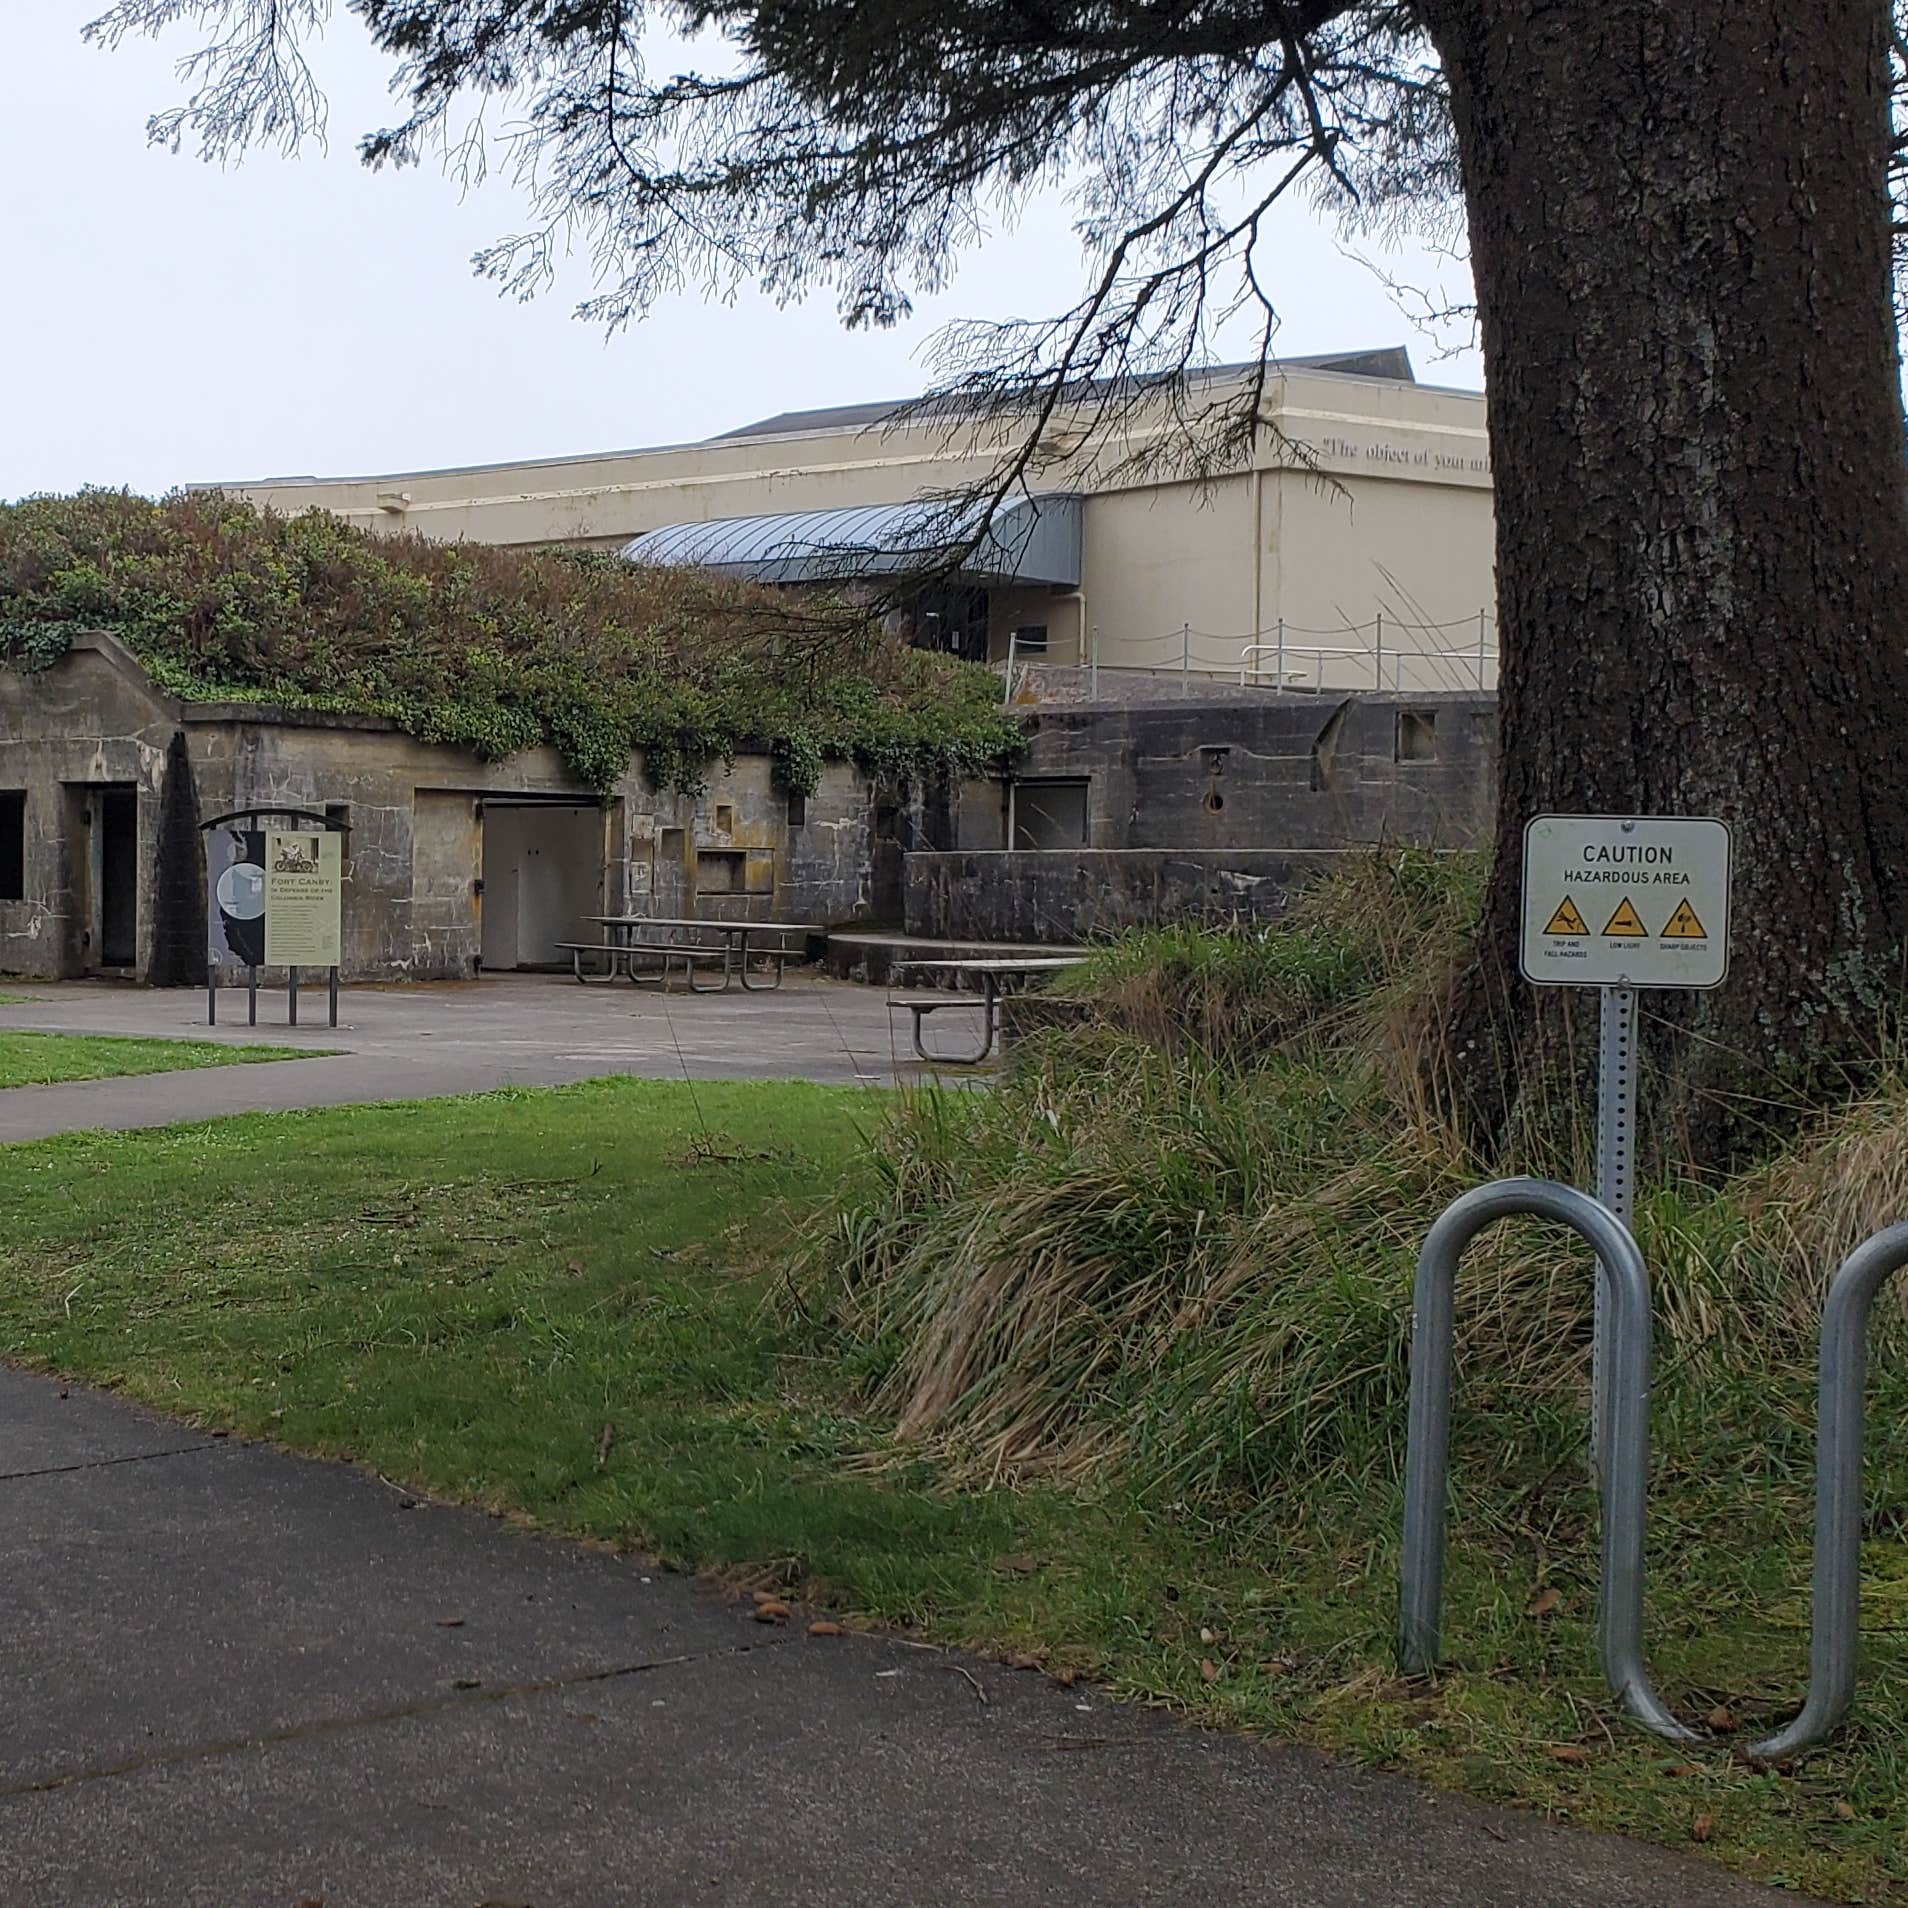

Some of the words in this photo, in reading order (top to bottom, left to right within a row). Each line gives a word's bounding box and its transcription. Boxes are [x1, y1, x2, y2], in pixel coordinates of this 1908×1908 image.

[1366, 443, 1409, 464] object
[1414, 447, 1429, 465] of
[1434, 454, 1464, 470] your
[1583, 845, 1673, 864] CAUTION
[271, 878, 295, 886] FORT
[1564, 870, 1649, 884] HAZARDOUS
[1653, 872, 1690, 885] AREA
[1552, 940, 1566, 948] TRIP
[1567, 940, 1580, 948] AND
